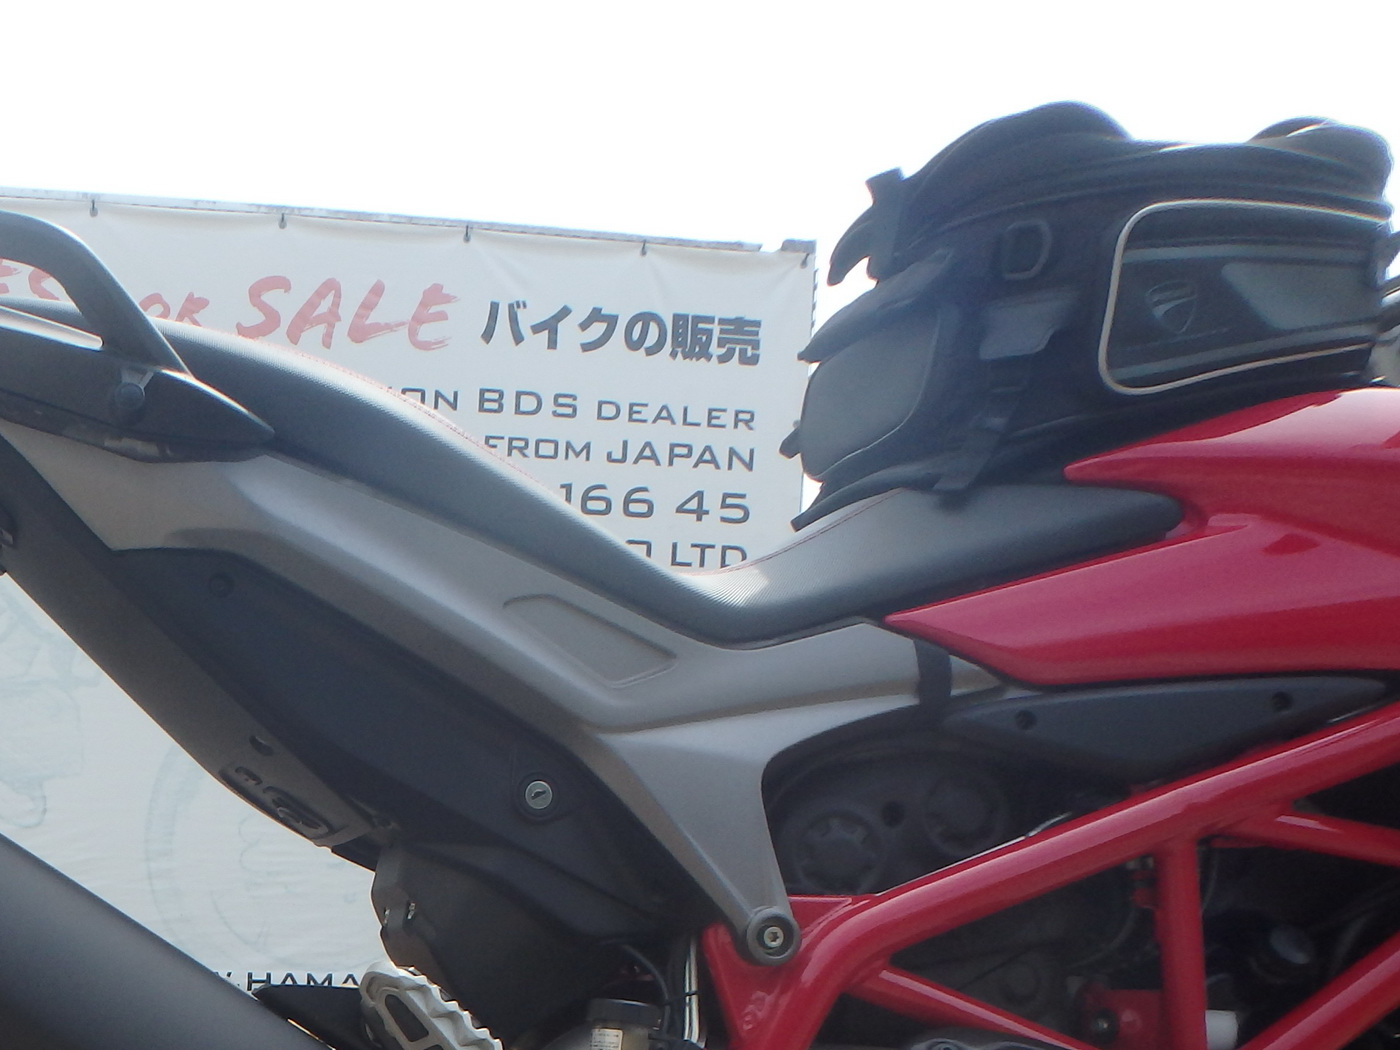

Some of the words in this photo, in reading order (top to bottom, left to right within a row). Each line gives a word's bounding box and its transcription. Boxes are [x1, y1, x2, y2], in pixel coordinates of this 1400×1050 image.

[236, 275, 459, 351] SALE
[480, 300, 762, 366] バイクの販売
[478, 387, 578, 418] BDS
[597, 400, 756, 430] DEALER
[485, 434, 592, 462] FROM
[606, 439, 755, 472] JAPAN
[675, 490, 750, 524] 45
[670, 541, 748, 570] LTD
